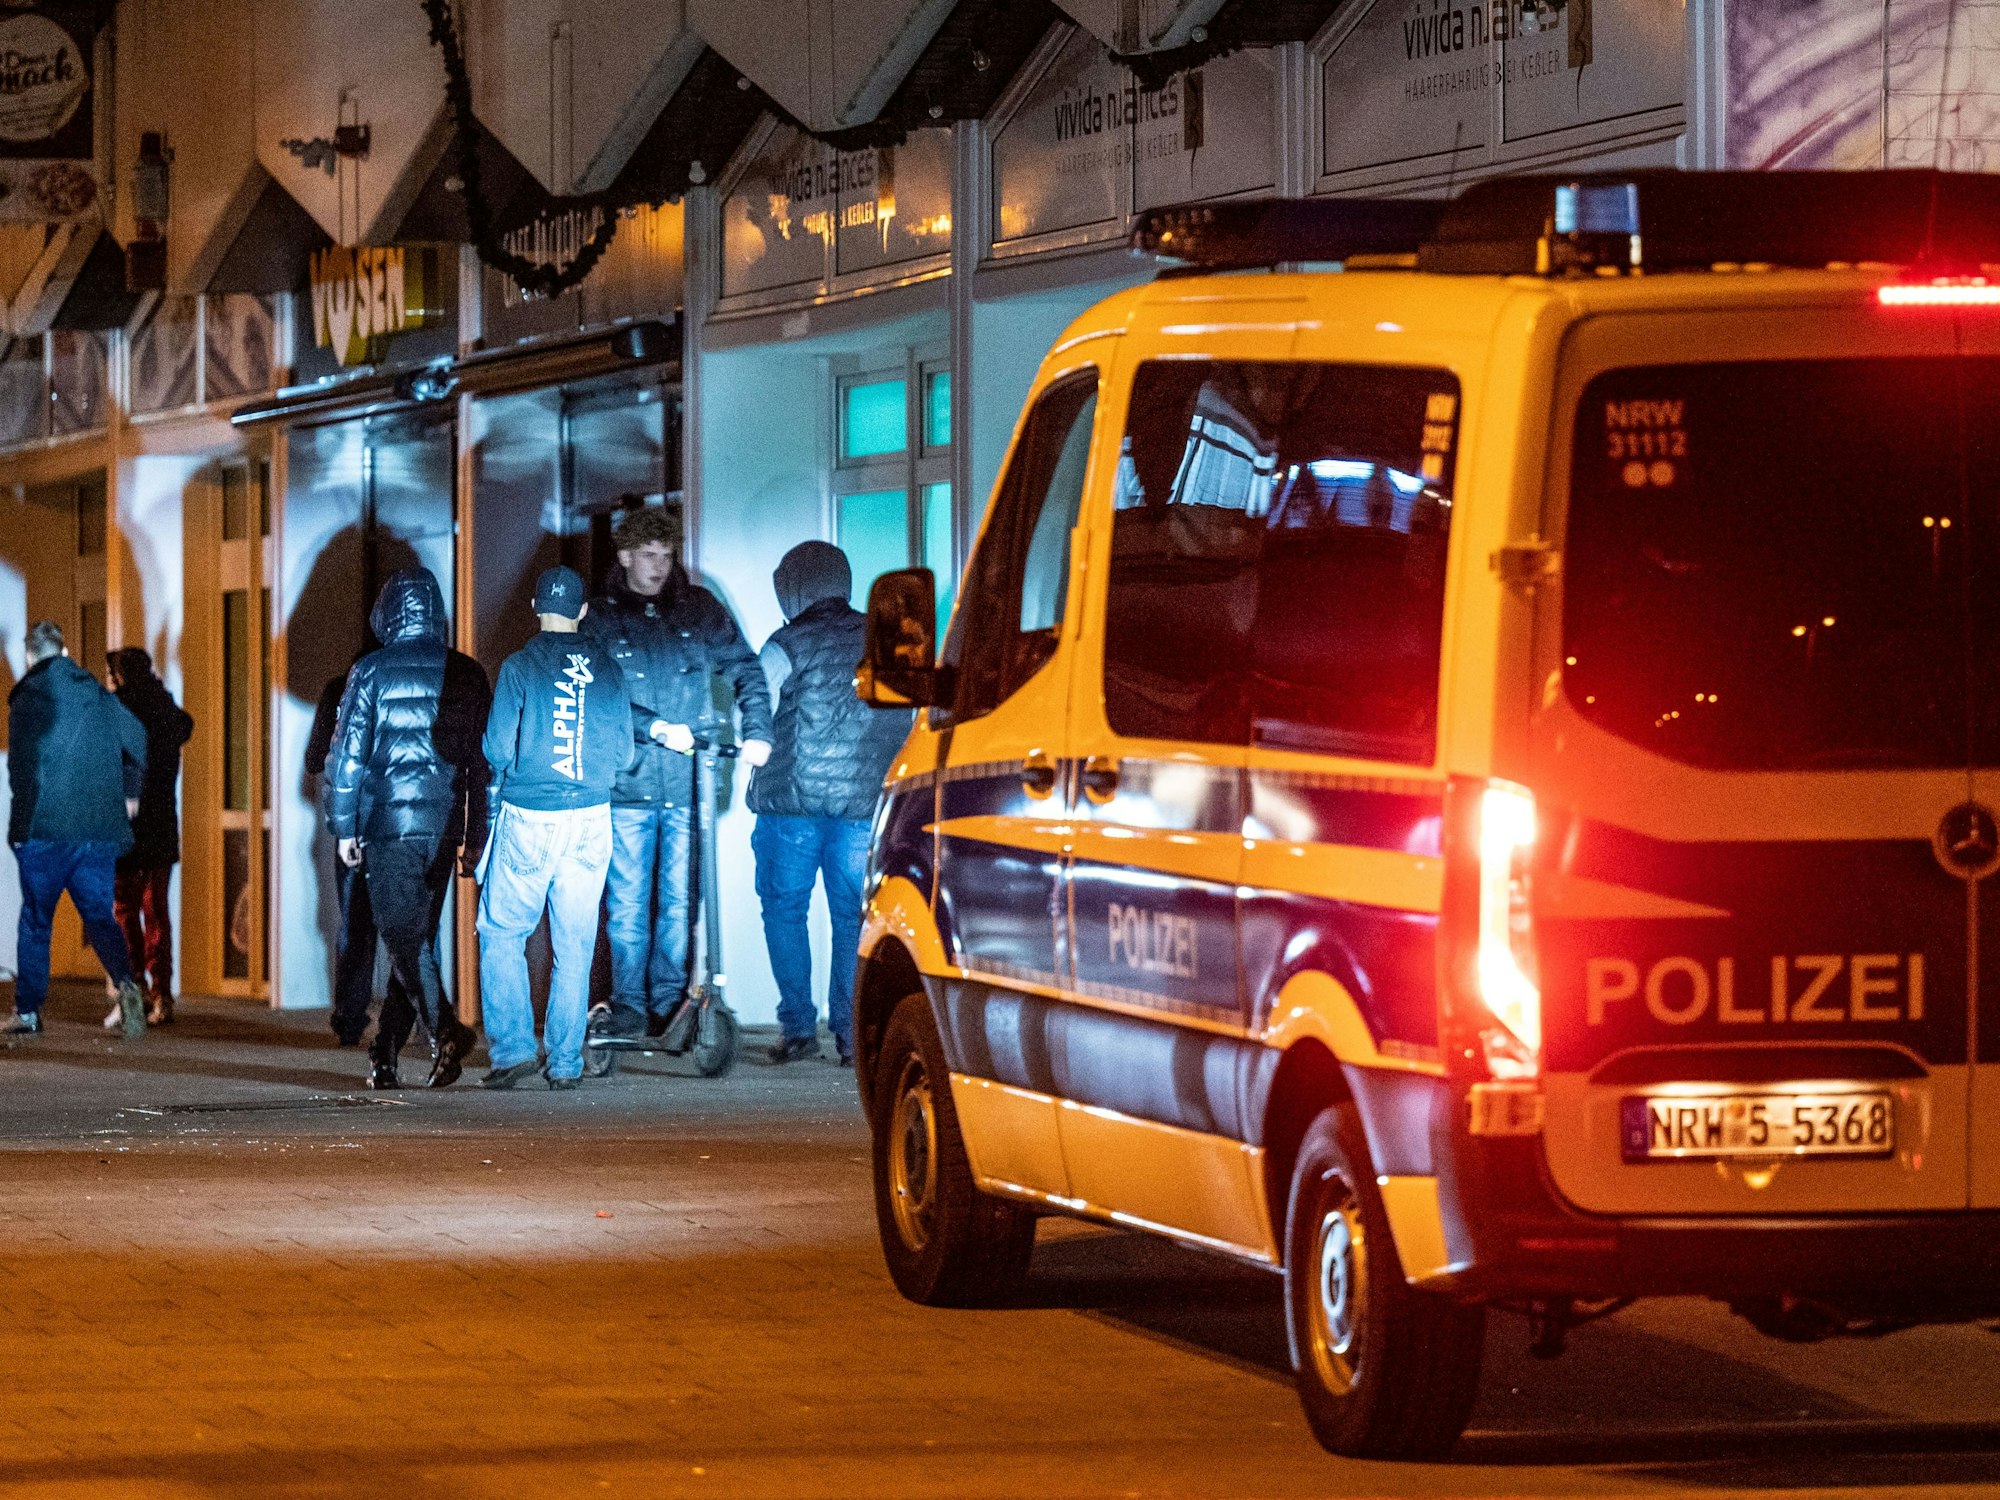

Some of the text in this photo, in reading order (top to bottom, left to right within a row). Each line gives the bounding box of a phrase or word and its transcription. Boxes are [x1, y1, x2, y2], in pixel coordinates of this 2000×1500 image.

[1403, 0, 1464, 61] vivida
[0, 46, 73, 92] nack
[1054, 85, 1102, 142] vivida
[1605, 400, 1683, 427] NRW
[1608, 431, 1686, 458] 31112
[550, 680, 577, 780] ALPHA
[1108, 903, 1198, 978] POLIZEI
[1585, 953, 1925, 1026] POLIZEI
[1651, 1105, 1725, 1149] NRW
[1749, 1102, 1887, 1146] 5-5368
